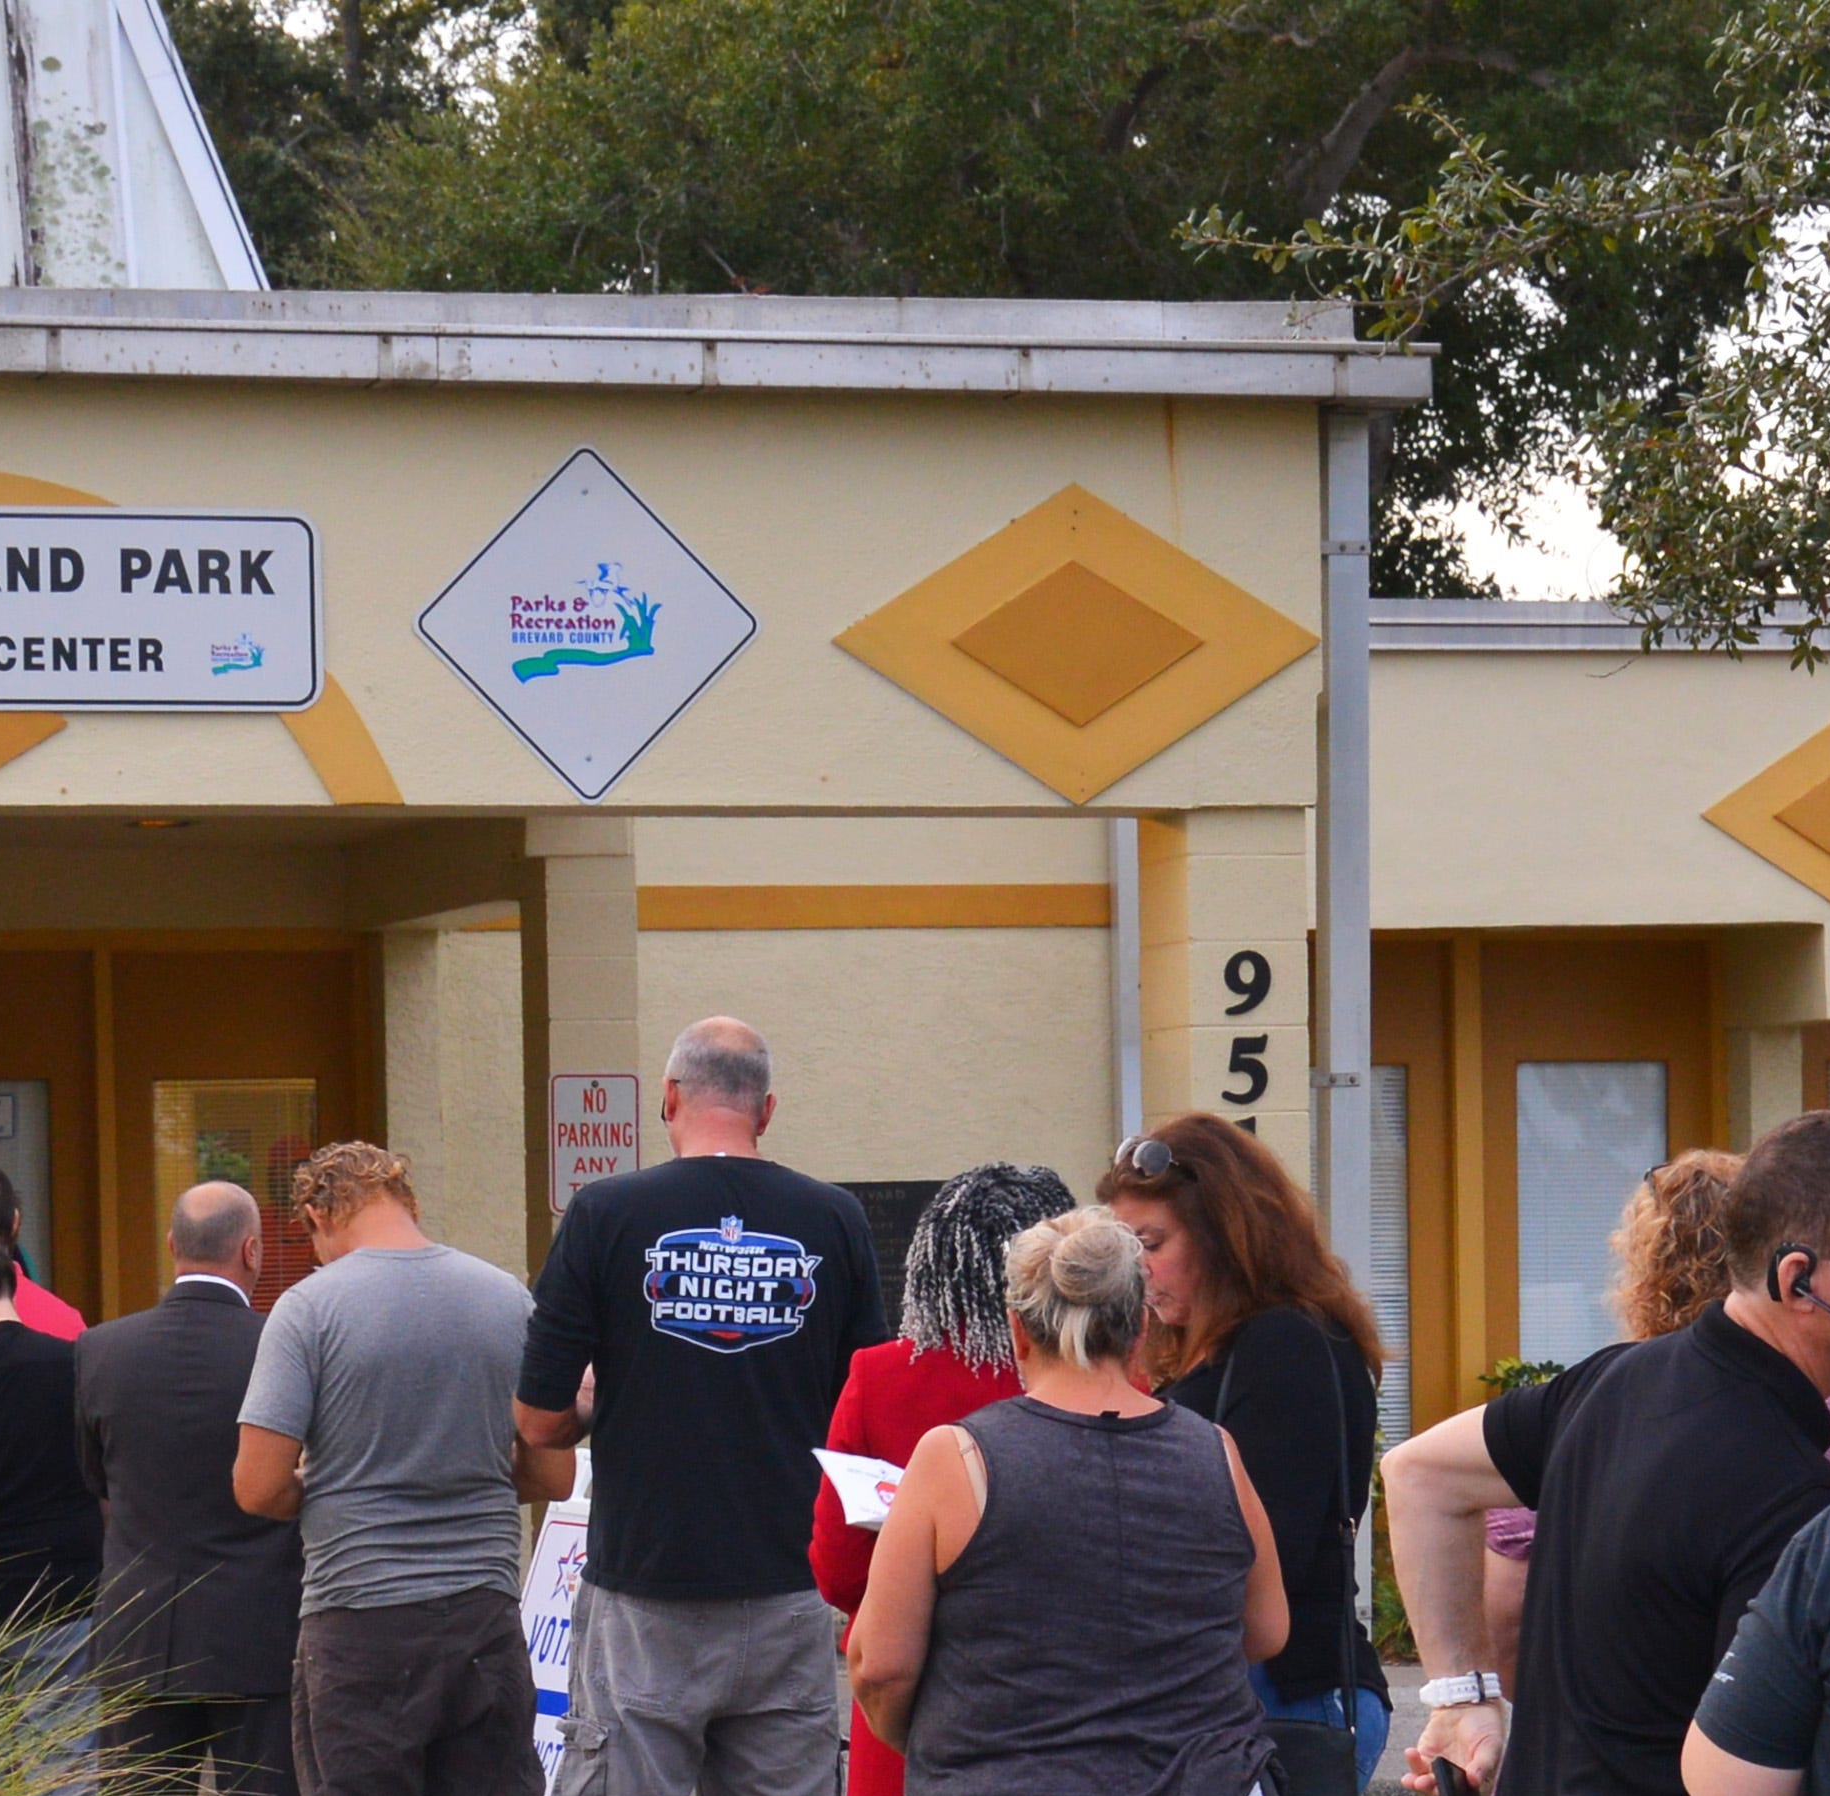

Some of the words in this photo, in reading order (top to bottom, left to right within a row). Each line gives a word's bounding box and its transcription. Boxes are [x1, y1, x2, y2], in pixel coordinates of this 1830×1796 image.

[120, 548, 275, 595] PARK
[510, 594, 567, 612] Parks
[572, 597, 589, 612] &
[510, 613, 616, 630] Recreation
[512, 632, 564, 644] BREVARD
[569, 632, 615, 644] COUNTY
[583, 1088, 607, 1113] NO
[558, 1123, 633, 1147] PARKING
[574, 1157, 618, 1173] ANY
[648, 1251, 819, 1279] THURSDAY
[679, 1275, 778, 1302] NIGHT
[655, 1301, 800, 1324] FOOTBALL
[529, 1614, 571, 1666] VOTI
